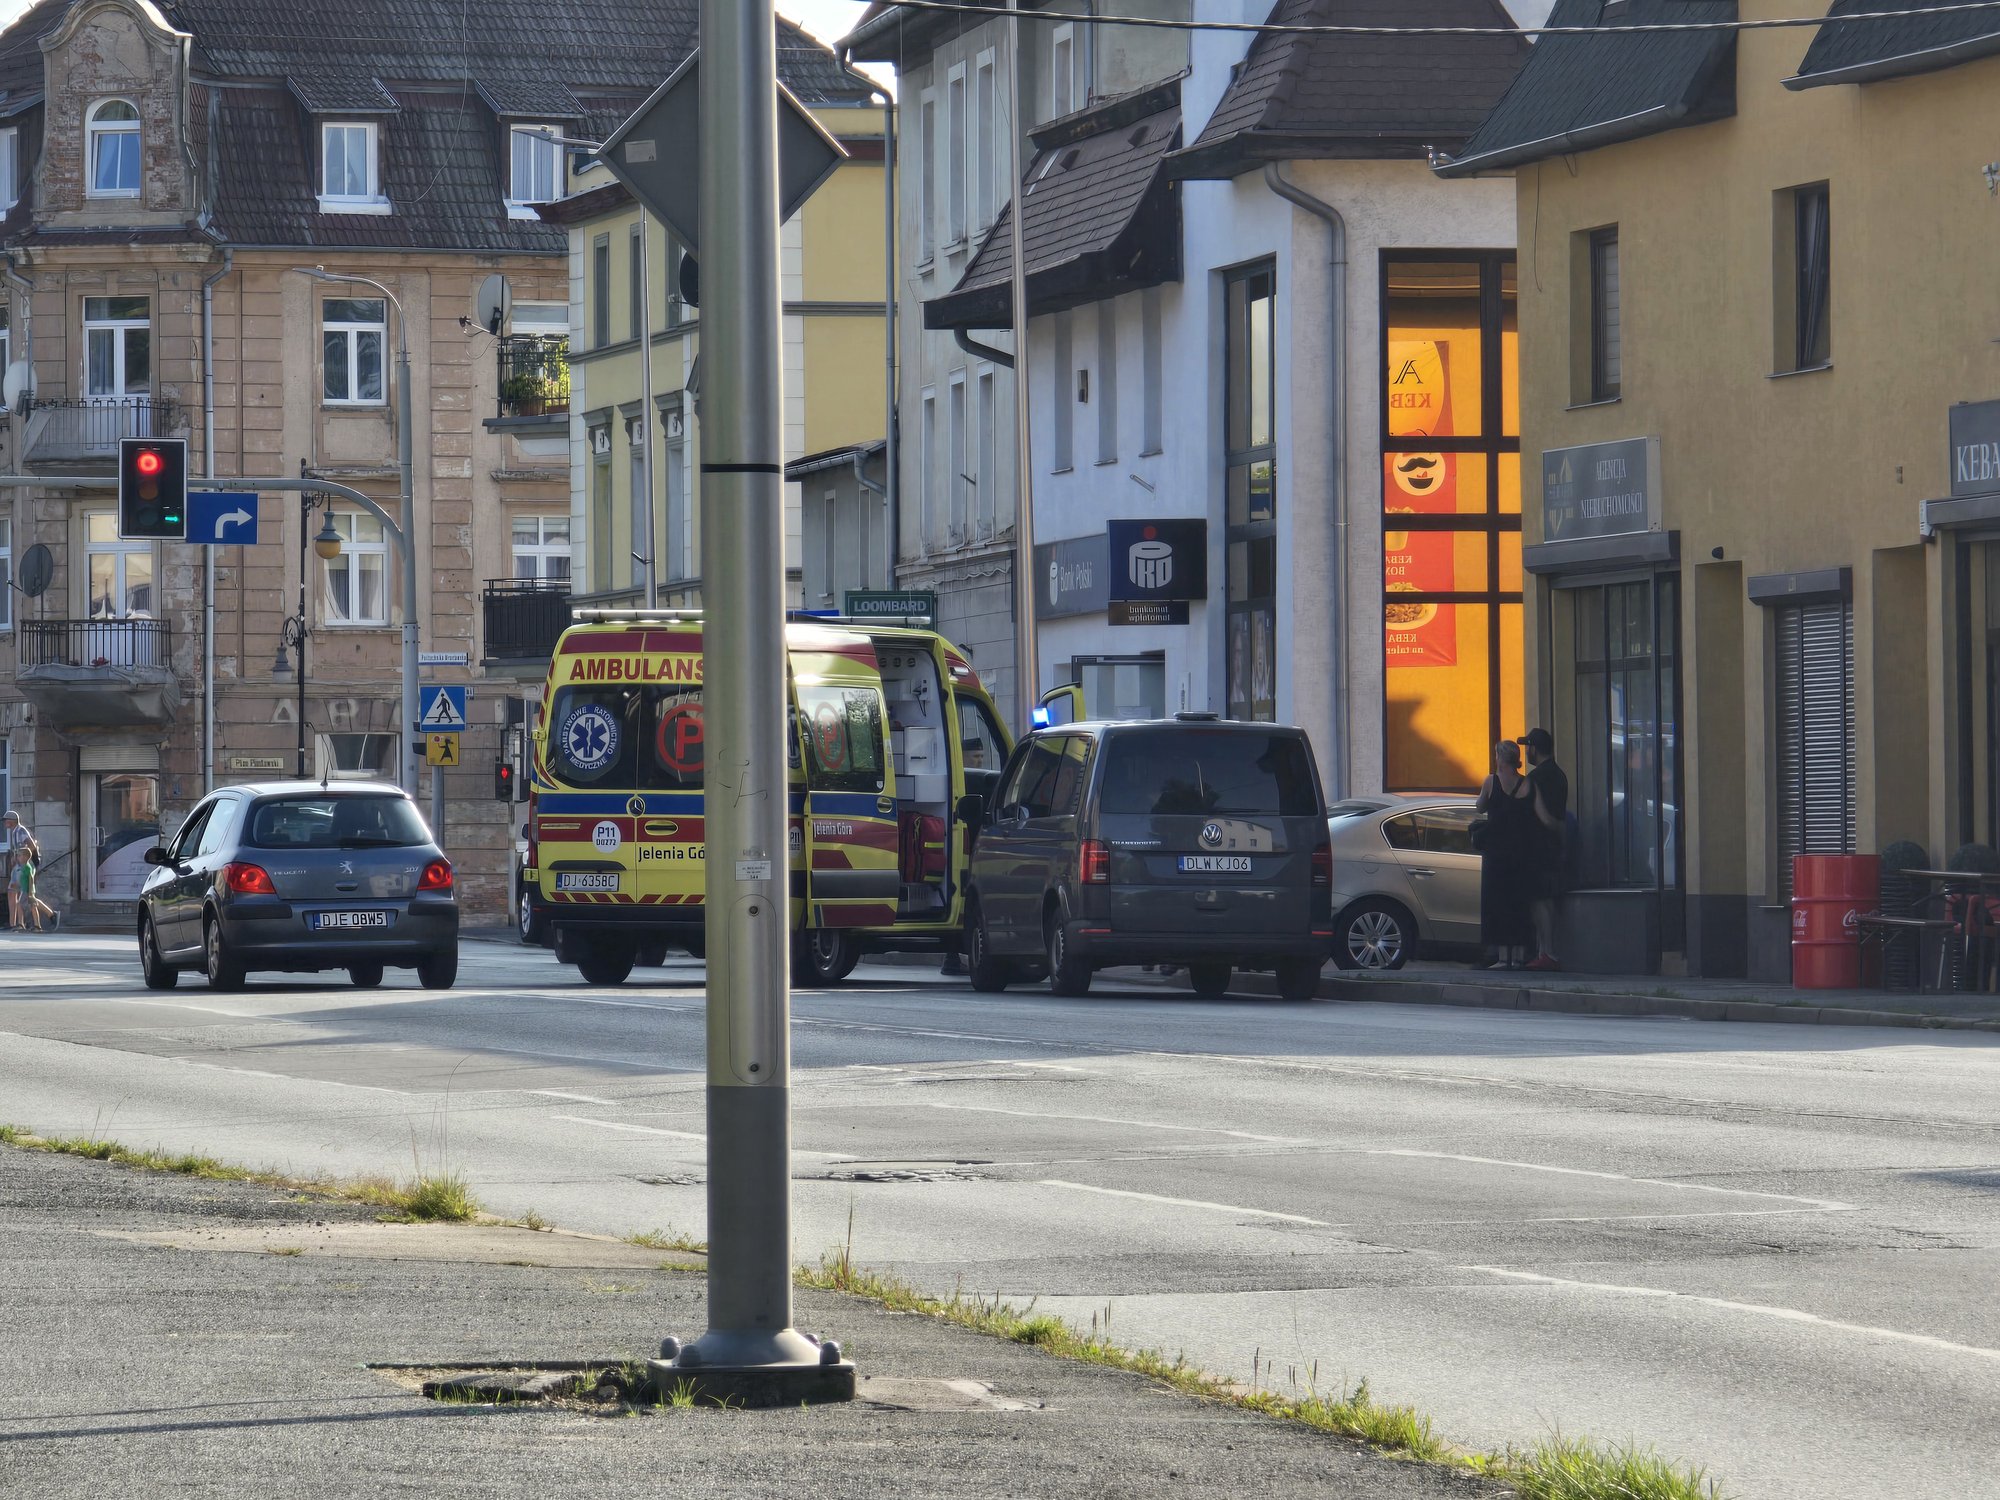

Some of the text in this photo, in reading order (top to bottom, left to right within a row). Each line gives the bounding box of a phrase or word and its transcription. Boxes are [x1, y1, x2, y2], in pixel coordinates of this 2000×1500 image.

[1597, 459, 1626, 485] AGENCJA
[854, 601, 927, 612] LOOMBARD
[1130, 605, 1168, 613] bankomat
[569, 755, 608, 770] MEDYCZNE
[597, 826, 616, 838] P11
[638, 846, 684, 862] Jelenia
[1186, 857, 1211, 870] DLW
[564, 874, 577, 887] DJ
[322, 912, 384, 926] DJE 08W5
